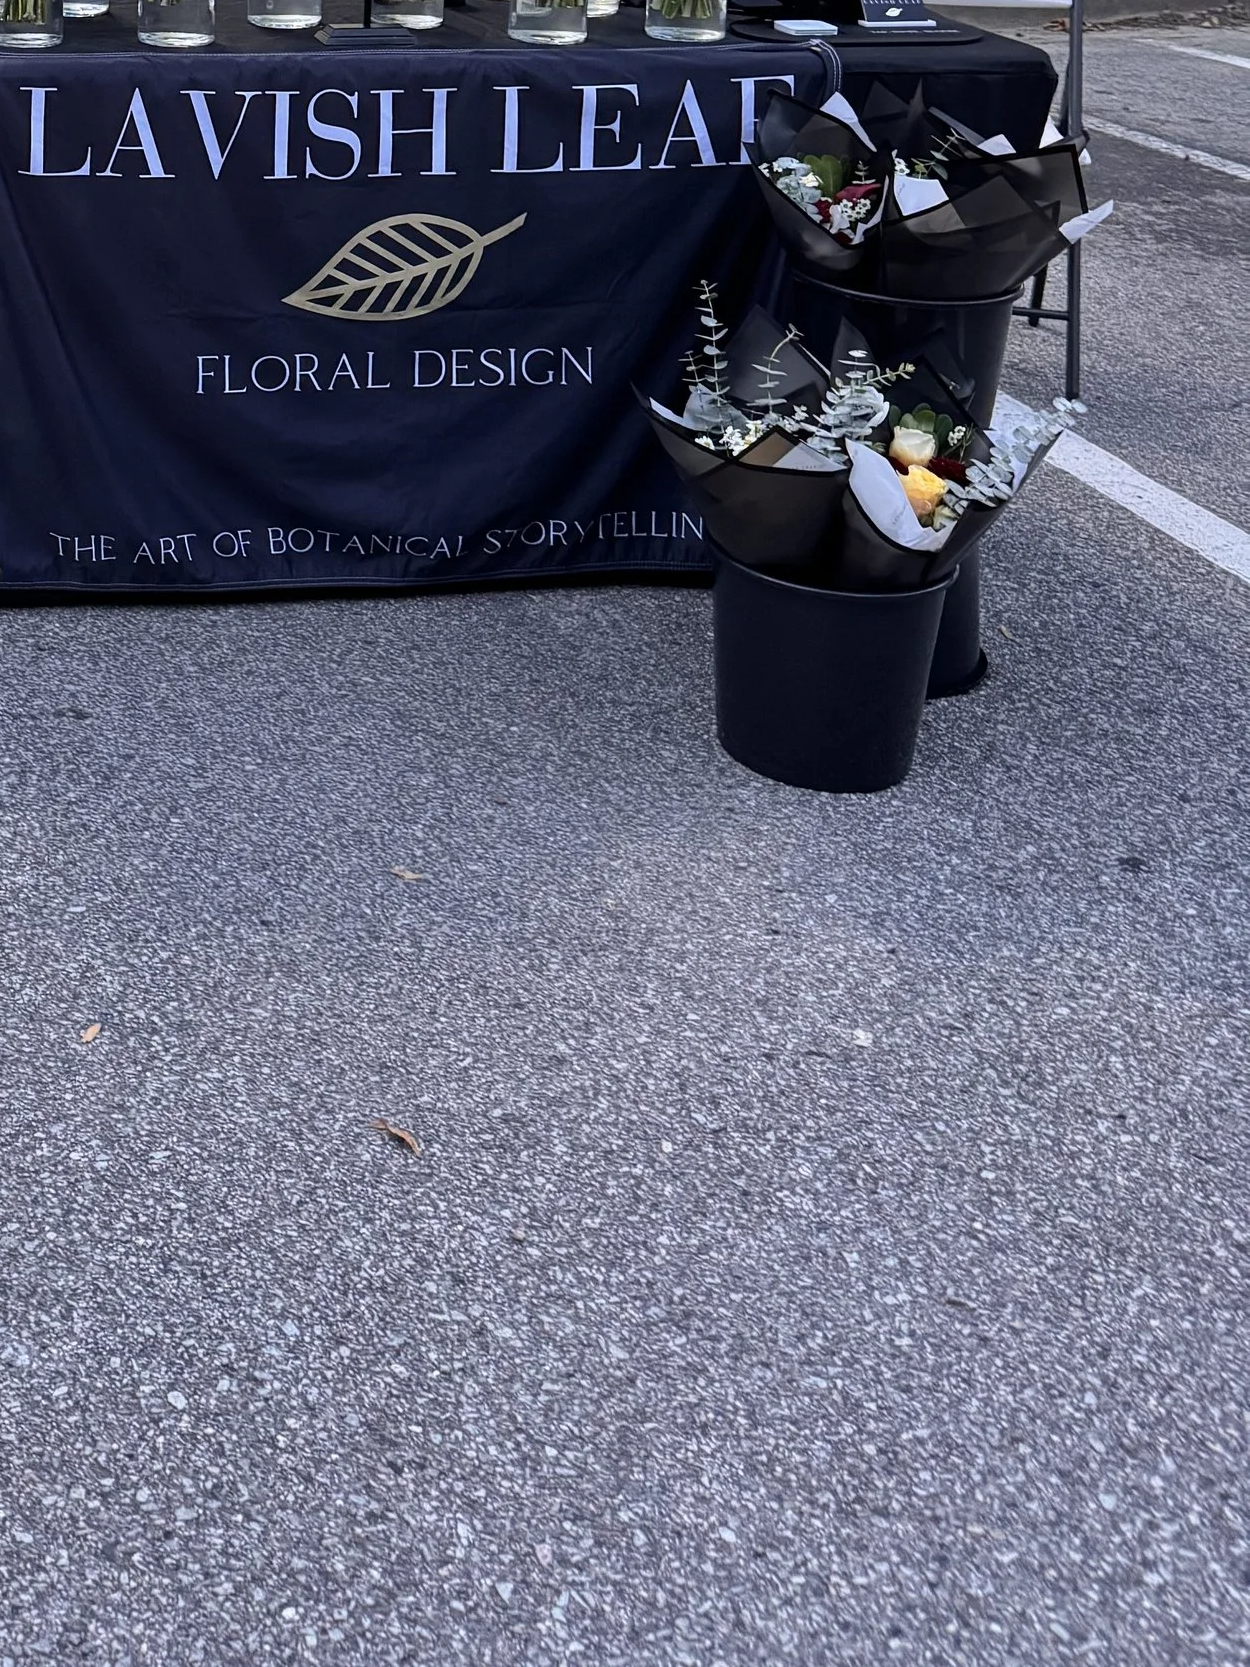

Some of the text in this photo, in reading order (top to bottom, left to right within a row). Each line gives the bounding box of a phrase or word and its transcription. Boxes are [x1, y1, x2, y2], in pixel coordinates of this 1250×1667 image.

[19, 74, 796, 179] LAVISH LEAF
[197, 347, 592, 393] FLORAL DESIGN
[50, 511, 703, 564] THE ART OF BOTANICAL STORYTELLIN
